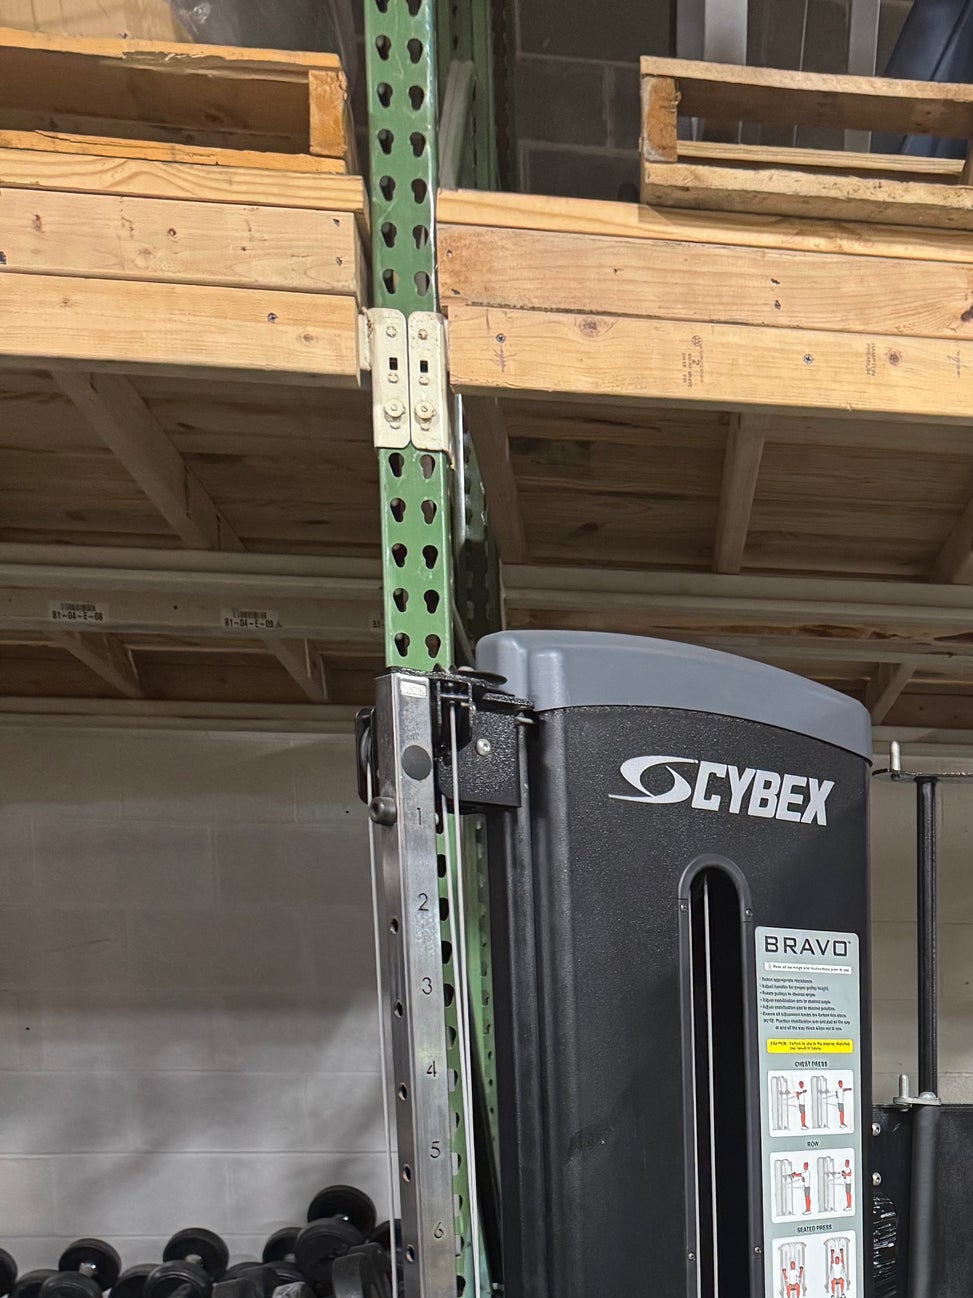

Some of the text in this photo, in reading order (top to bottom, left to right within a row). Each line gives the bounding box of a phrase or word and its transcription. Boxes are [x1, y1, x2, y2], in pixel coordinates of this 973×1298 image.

[691, 761, 835, 826] CYBEX
[418, 893, 429, 911] 2
[765, 935, 847, 957] BRAVO
[422, 977, 432, 994] 3
[426, 1060, 437, 1077] 4
[430, 1141, 441, 1158] 5
[434, 1222, 444, 1238] 6
